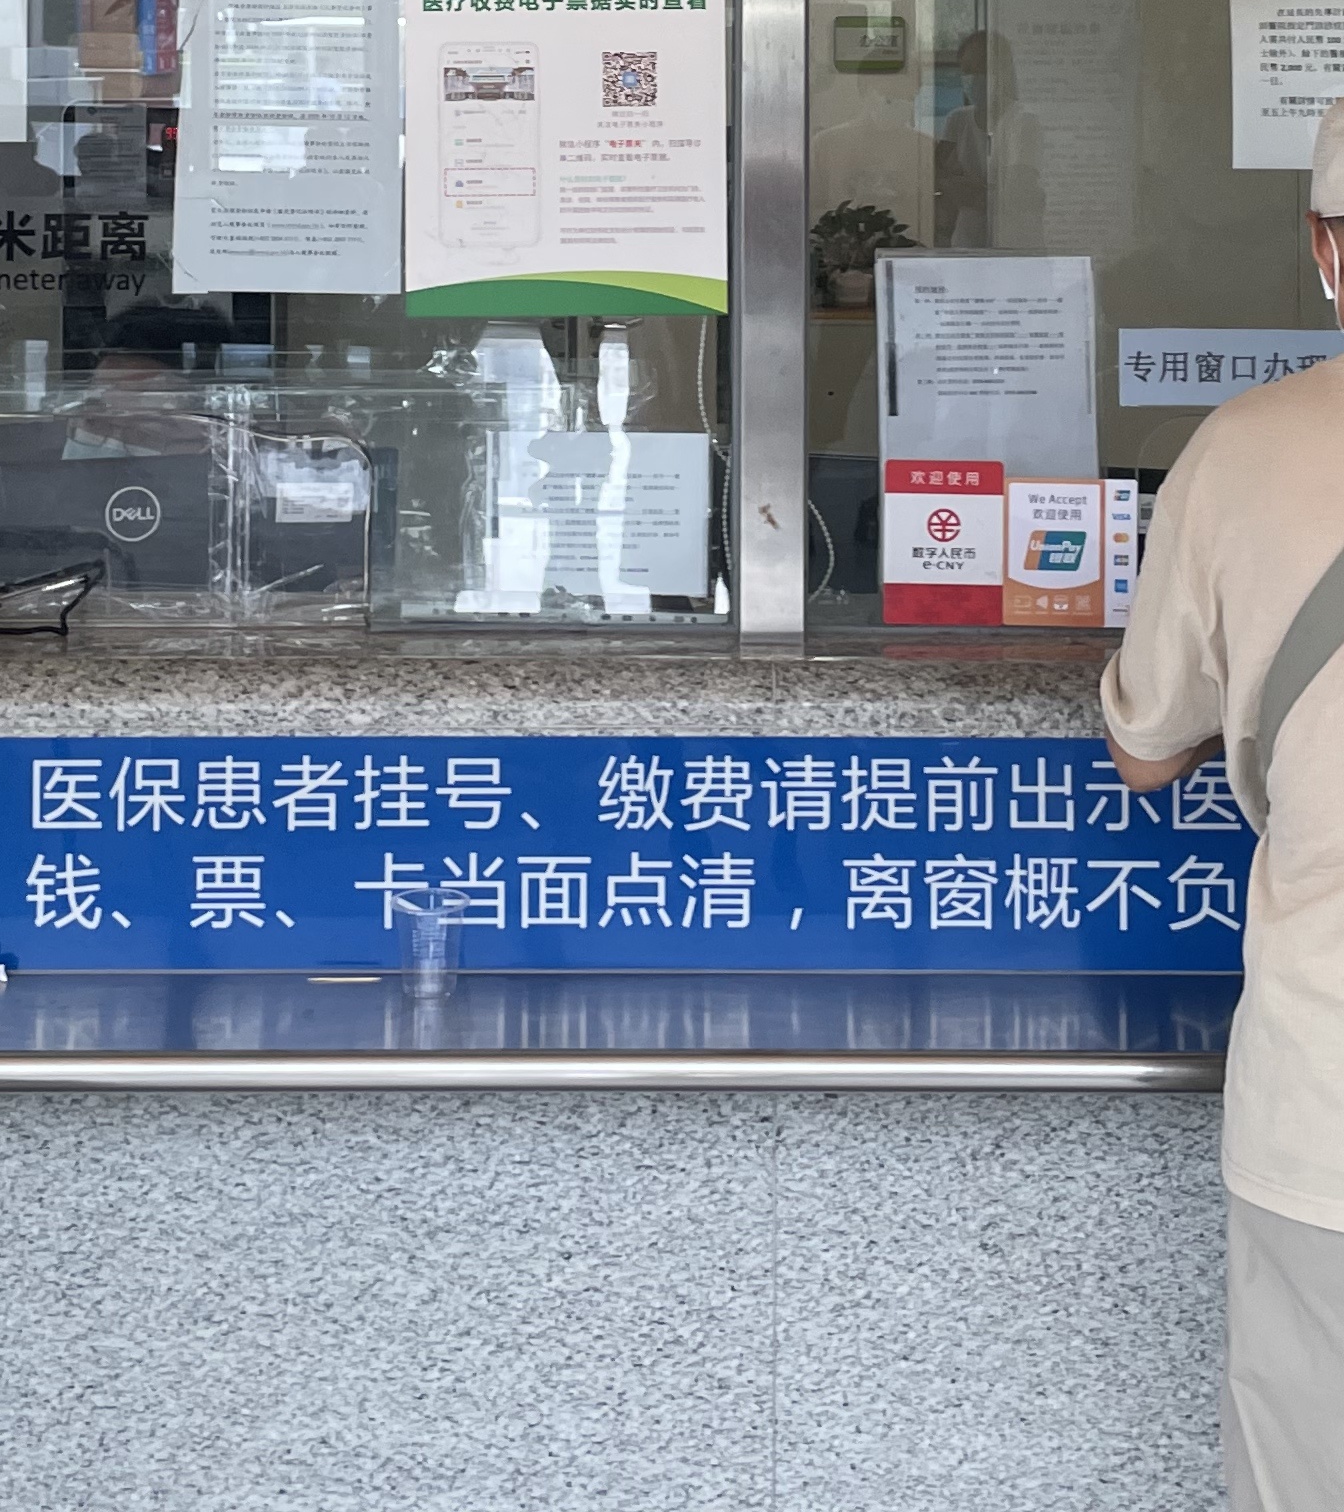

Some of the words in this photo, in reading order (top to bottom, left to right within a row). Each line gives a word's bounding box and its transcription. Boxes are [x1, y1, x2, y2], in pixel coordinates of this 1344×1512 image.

[910, 471, 980, 486] 欢迎使用
[112, 507, 155, 522] DELL
